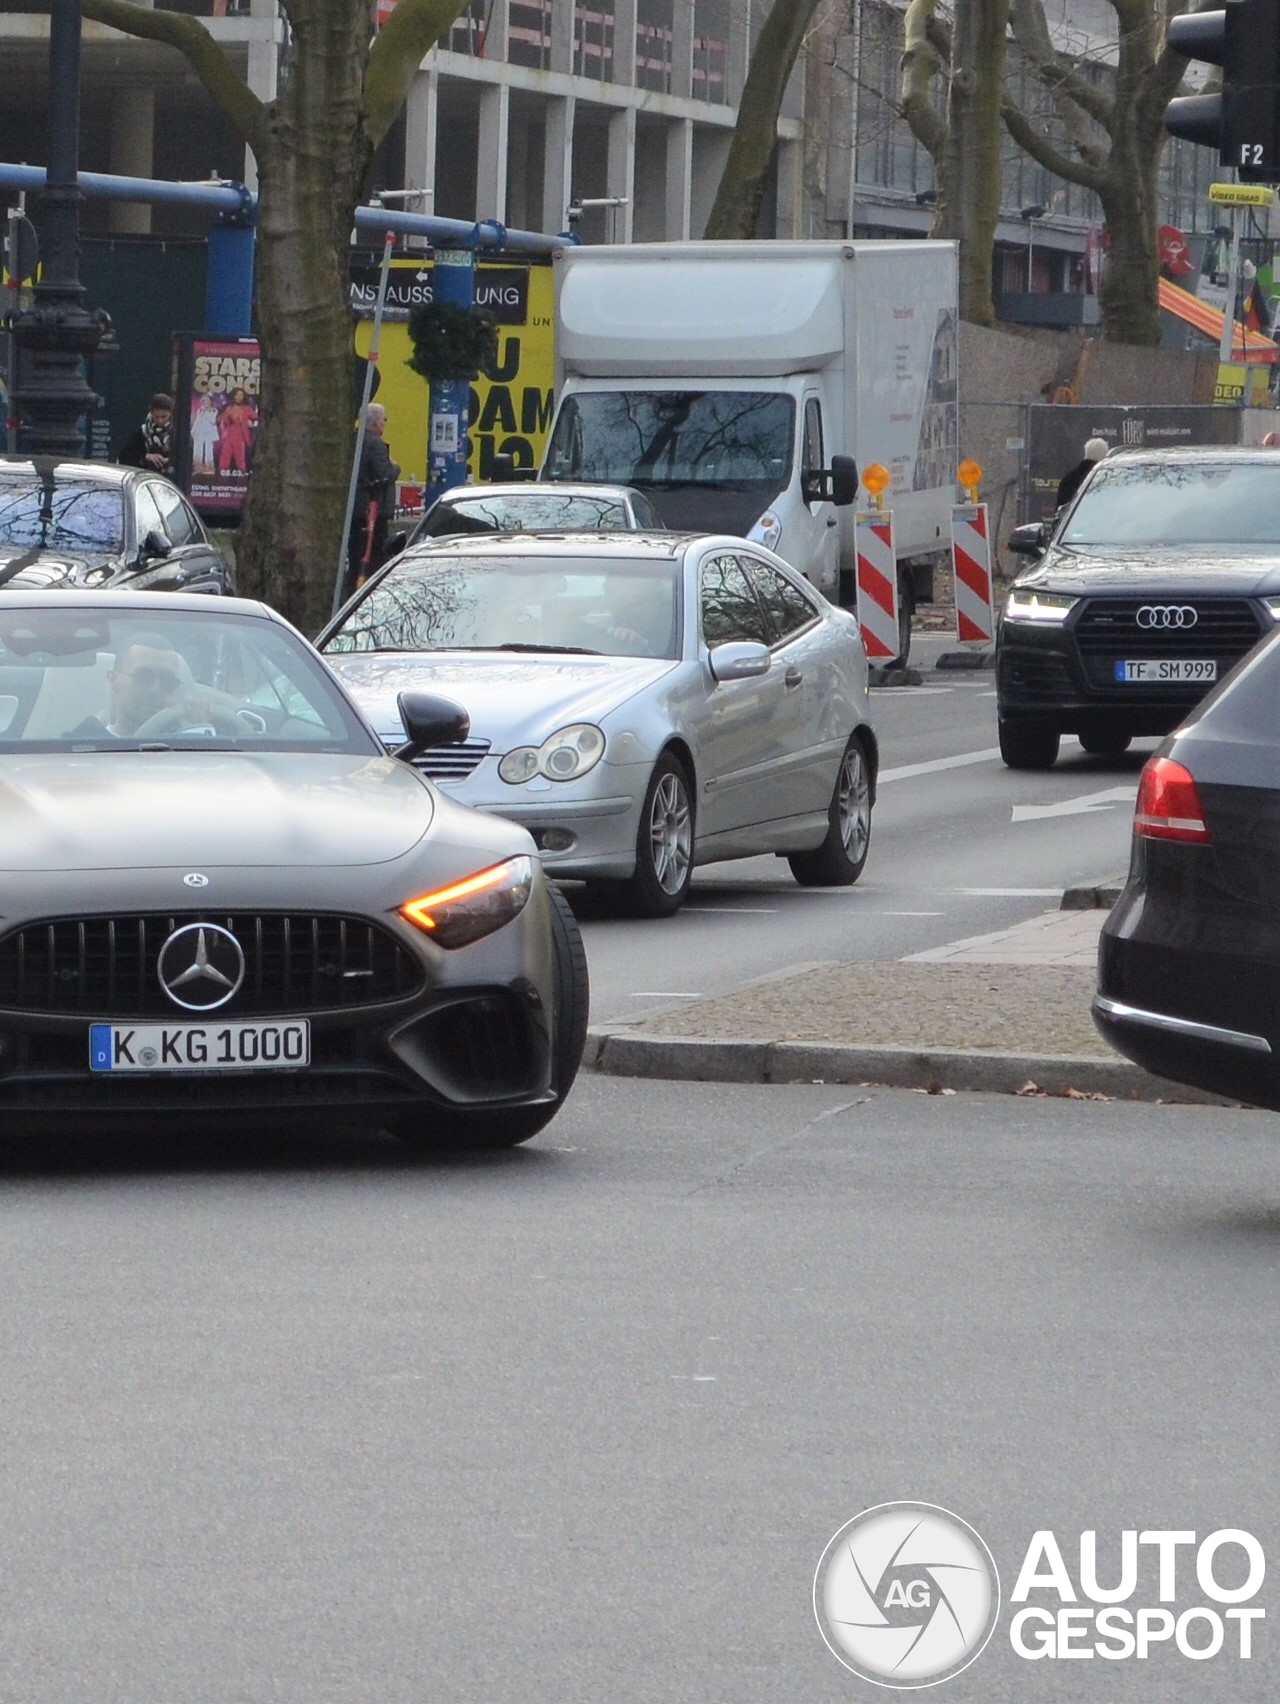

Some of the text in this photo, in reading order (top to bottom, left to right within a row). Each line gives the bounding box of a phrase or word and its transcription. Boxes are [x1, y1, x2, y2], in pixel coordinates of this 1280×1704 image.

[1210, 192, 1234, 201] VIDEO
[1126, 662, 1214, 678] TF SM 999
[114, 1026, 304, 1065] K KG 1000
